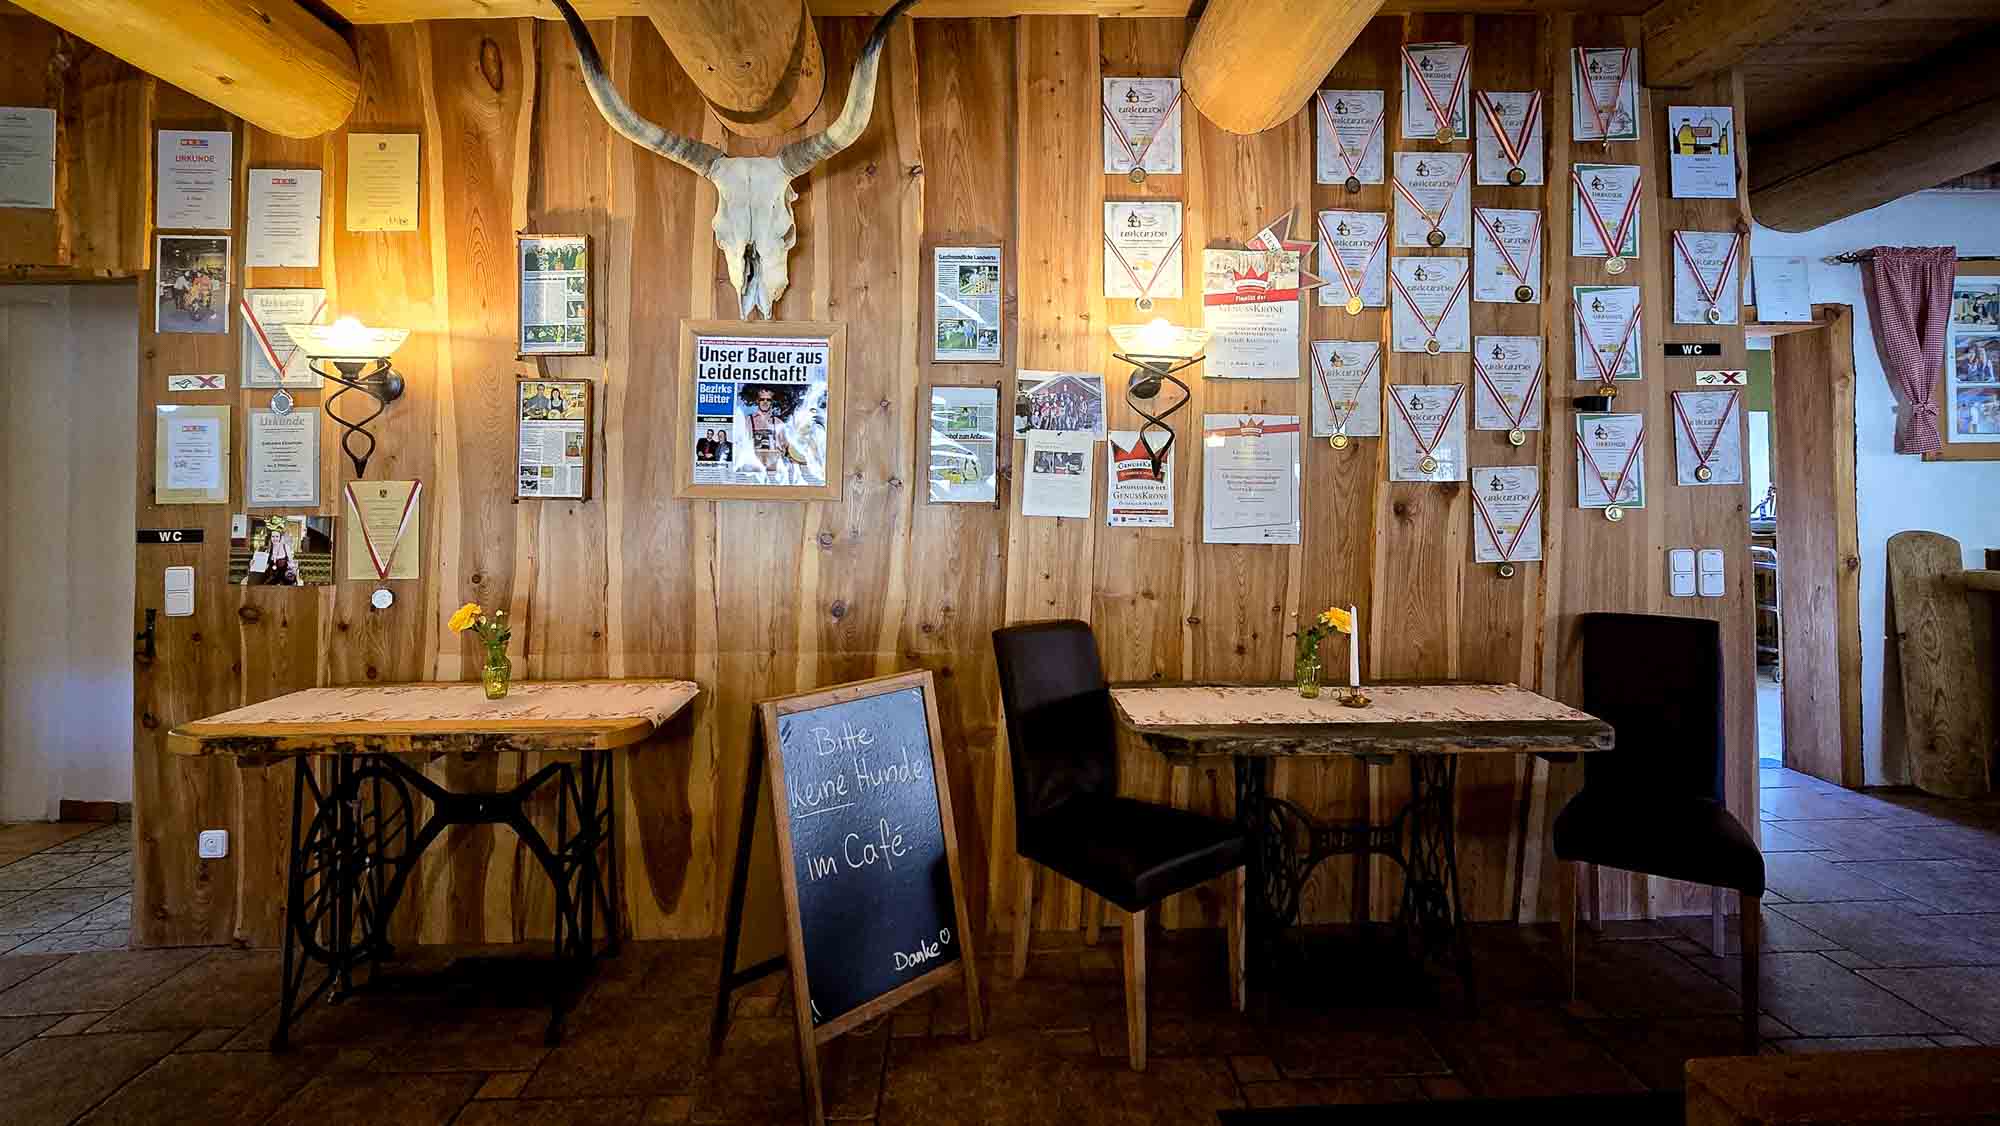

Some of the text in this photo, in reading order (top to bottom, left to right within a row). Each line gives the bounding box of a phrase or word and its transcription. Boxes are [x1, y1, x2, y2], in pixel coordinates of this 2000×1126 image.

[699, 346, 823, 365] Unser Bauer aus
[1682, 344, 1702, 354] WC
[699, 363, 807, 382] Leidenschaft!
[699, 383, 733, 394] Bezirks
[699, 394, 730, 404] Blätter
[159, 531, 182, 542] WC
[811, 722, 874, 756] Bitte
[853, 748, 924, 792] Hunde
[806, 851, 838, 881] im
[893, 939, 941, 971] Danke
